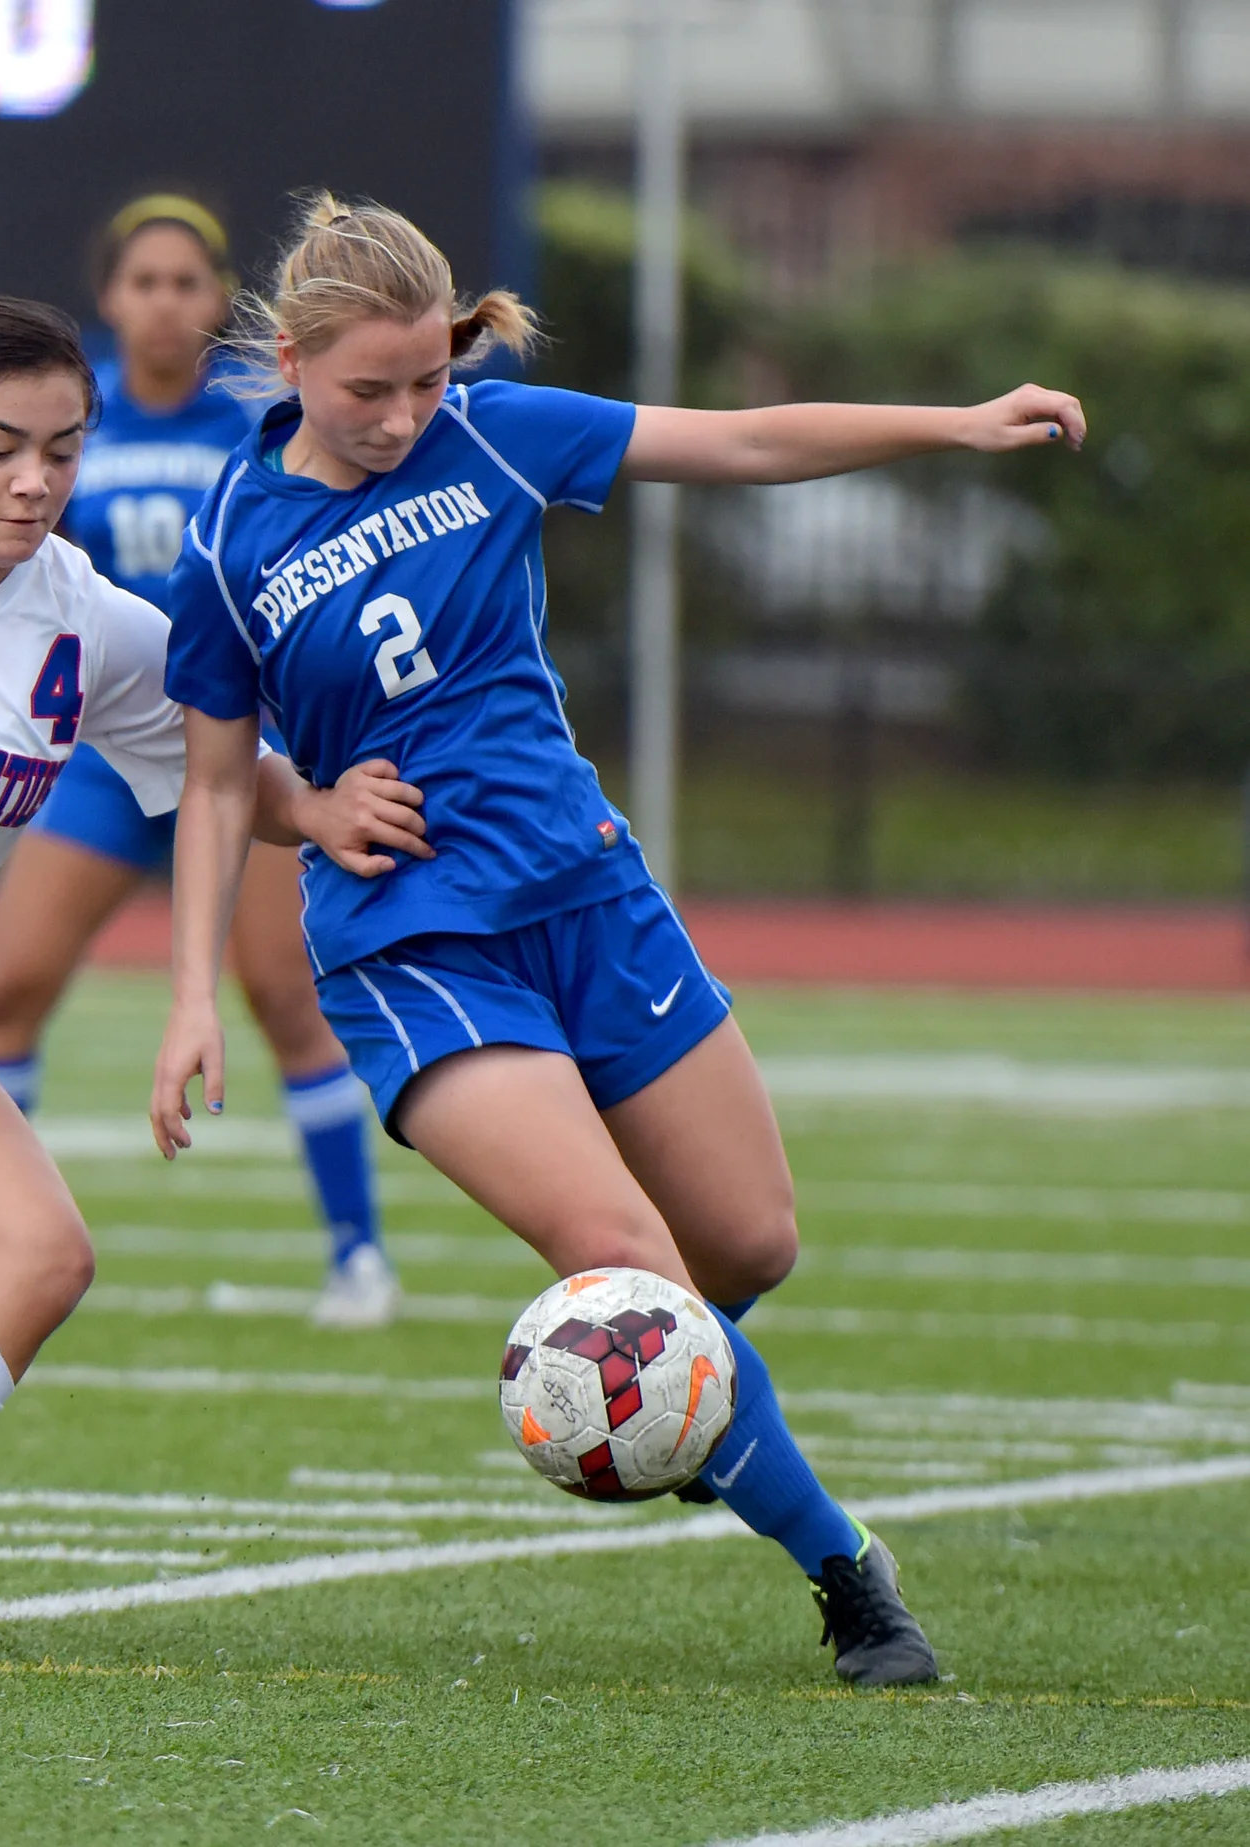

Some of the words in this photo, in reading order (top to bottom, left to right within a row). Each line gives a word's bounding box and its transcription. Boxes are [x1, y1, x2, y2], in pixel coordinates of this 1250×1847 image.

[107, 493, 187, 580] 10
[252, 482, 491, 640] PRESENTATION
[31, 633, 84, 745] 4
[358, 592, 439, 700] 2
